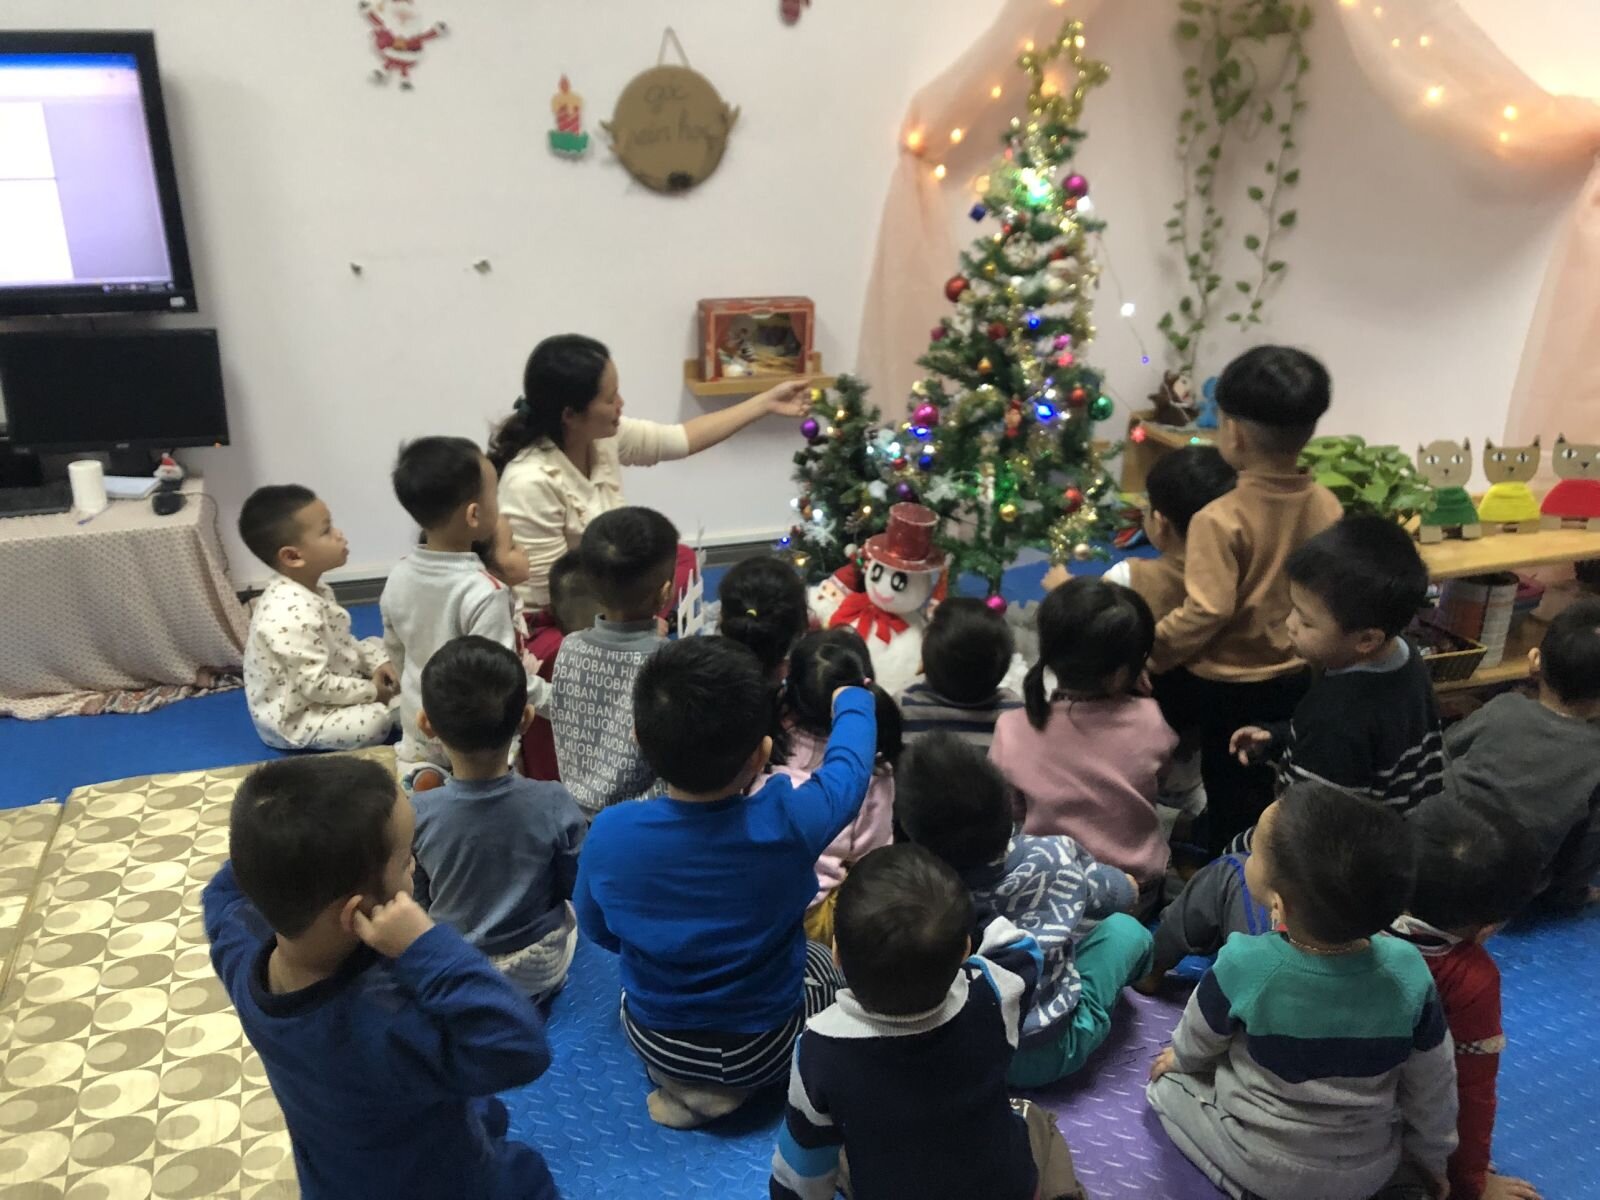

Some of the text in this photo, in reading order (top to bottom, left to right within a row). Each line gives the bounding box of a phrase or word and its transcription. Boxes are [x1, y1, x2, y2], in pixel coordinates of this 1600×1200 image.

[553, 663, 581, 682] OBAN
[568, 654, 616, 676] HUOBAN
[563, 696, 613, 718] HUOBAN
[549, 707, 579, 725] OBAN
[583, 715, 626, 738] HUOBAN
[564, 737, 605, 761] HUOBAN
[600, 733, 639, 758] HUOBAN
[581, 756, 618, 781] HUOBAN
